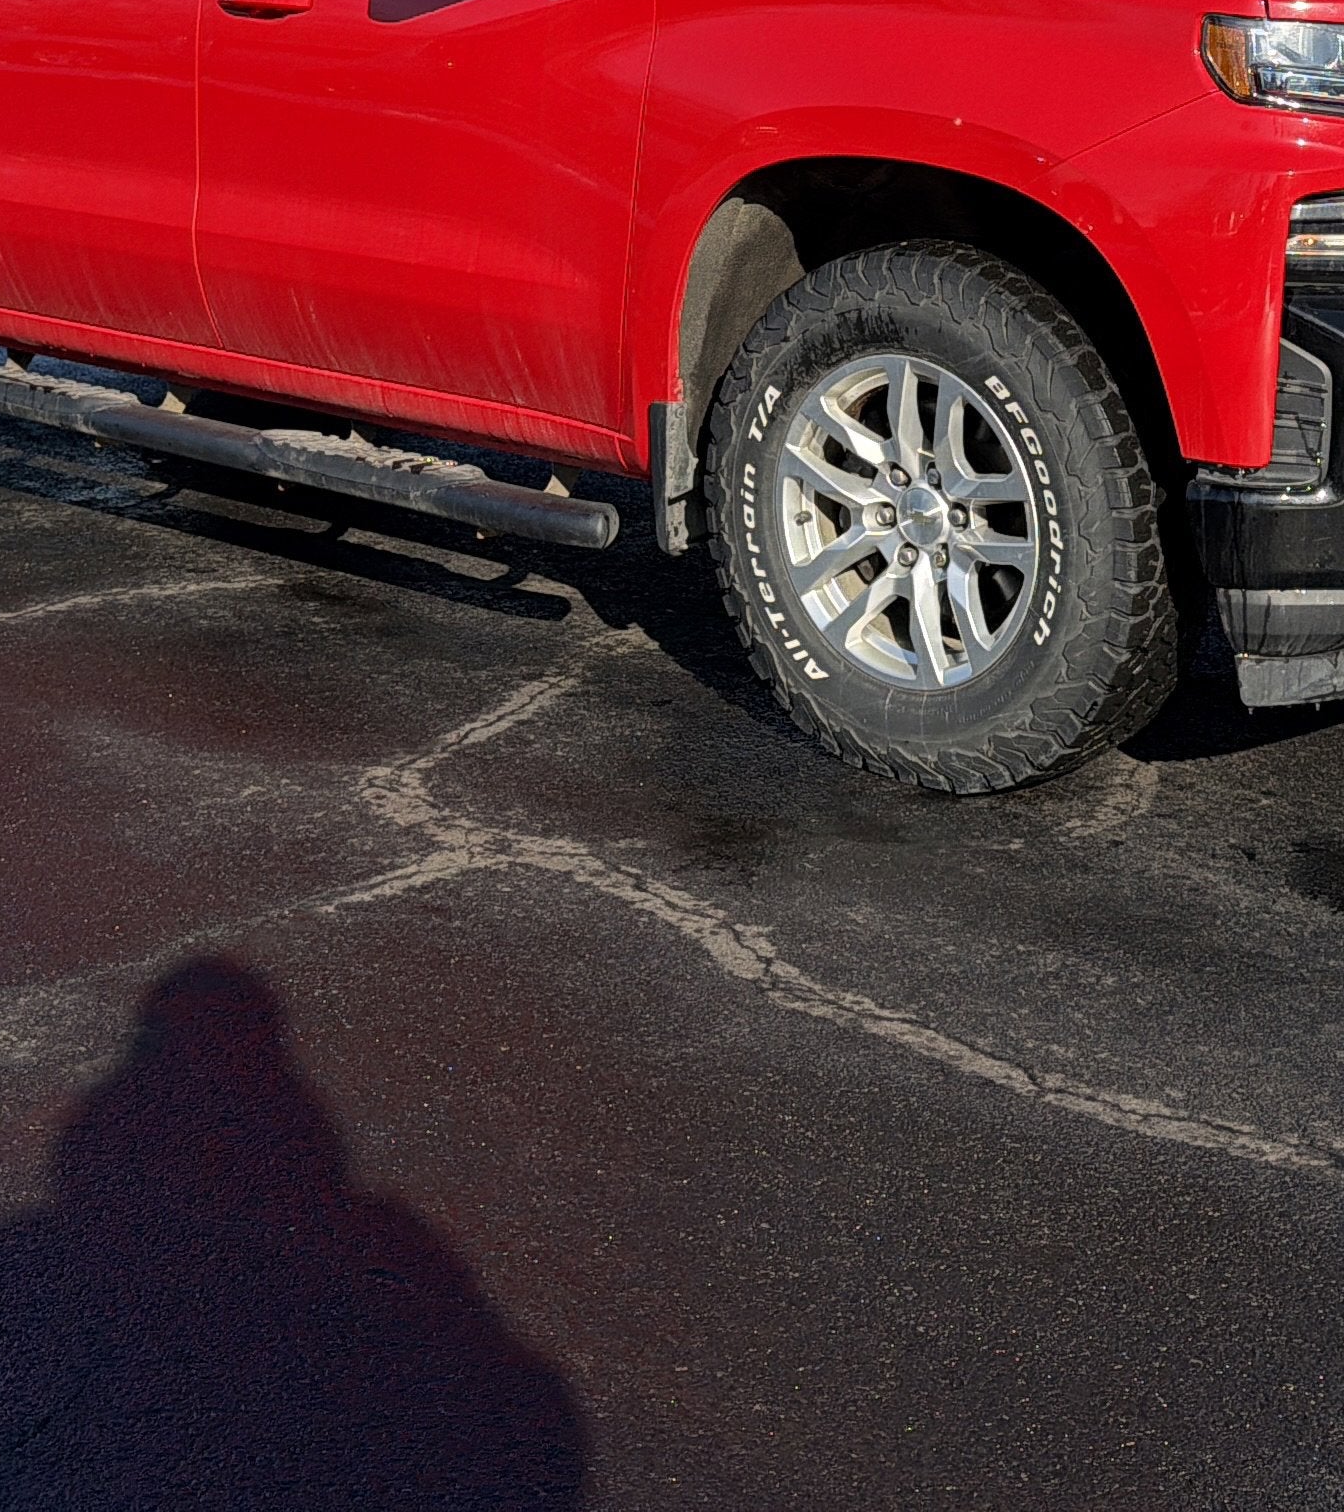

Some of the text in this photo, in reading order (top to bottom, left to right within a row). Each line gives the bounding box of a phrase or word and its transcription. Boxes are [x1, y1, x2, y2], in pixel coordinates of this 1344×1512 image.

[740, 385, 829, 680] All-Terrain T/A
[984, 376, 1064, 646] BFGoodrich
